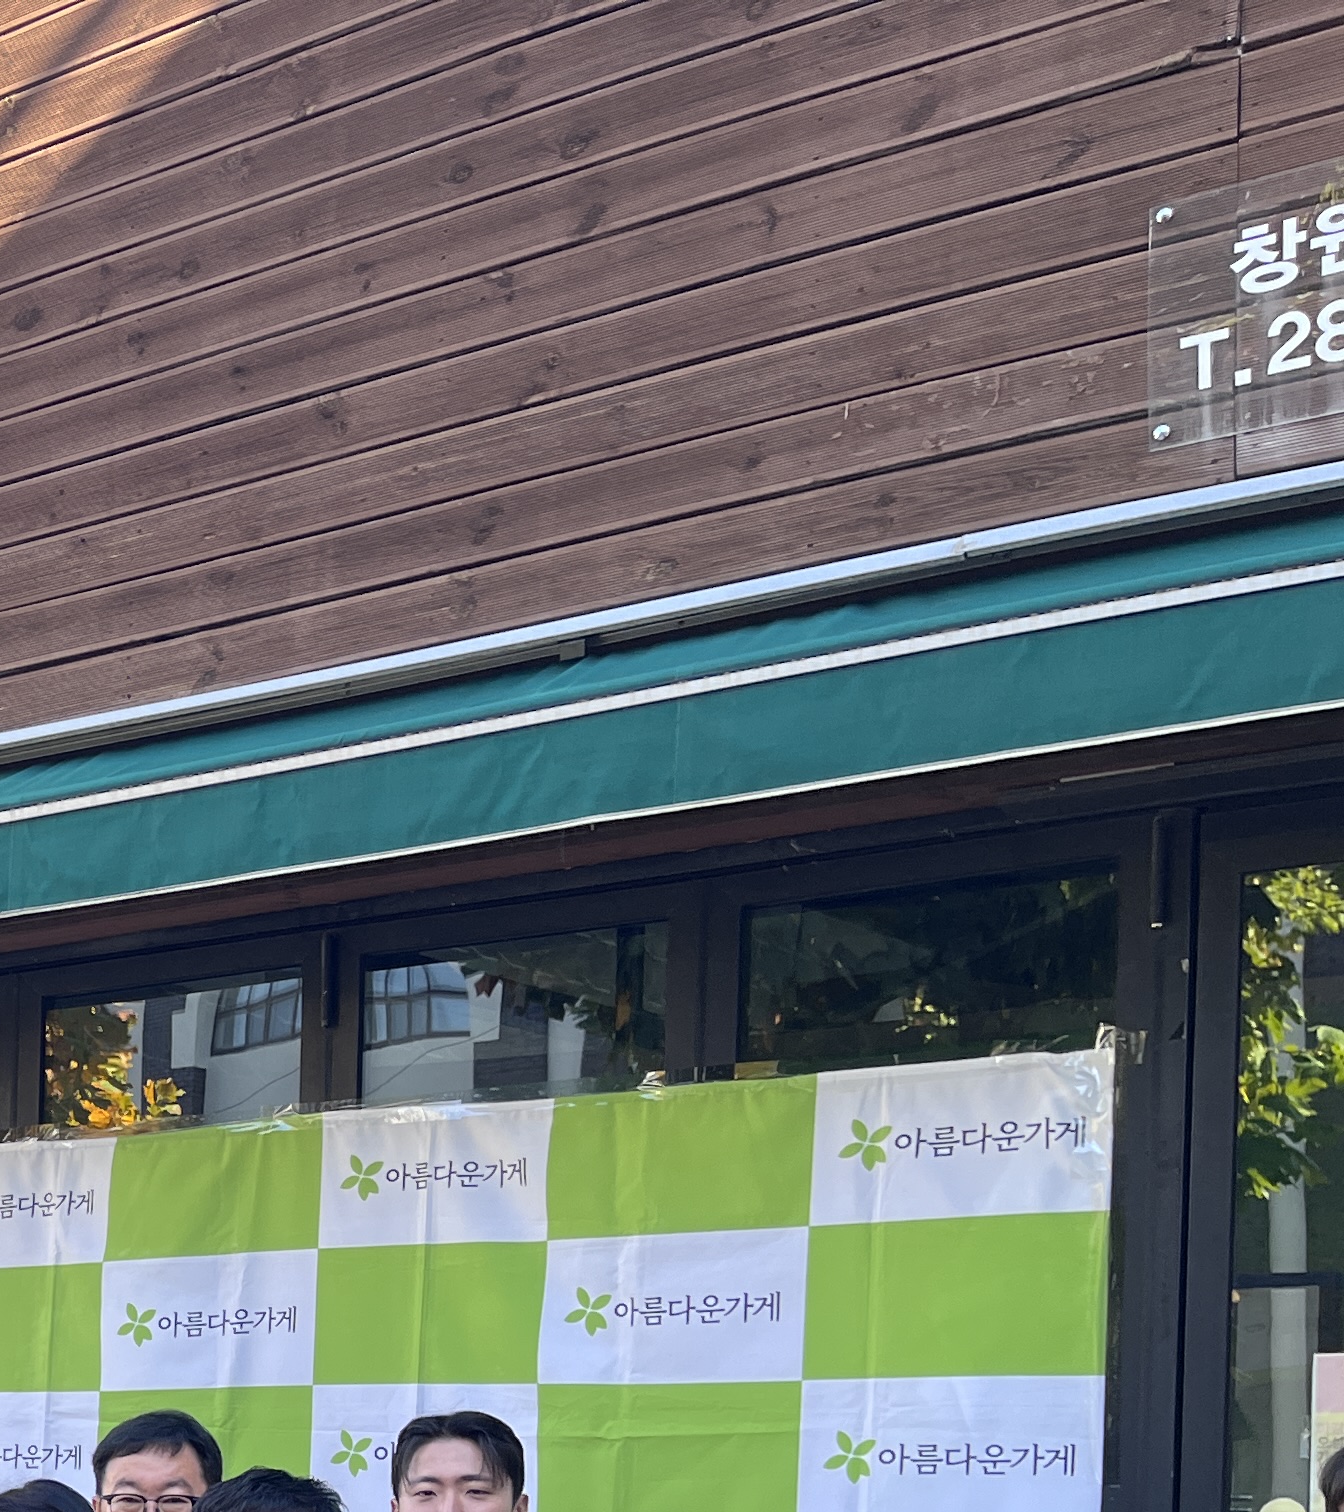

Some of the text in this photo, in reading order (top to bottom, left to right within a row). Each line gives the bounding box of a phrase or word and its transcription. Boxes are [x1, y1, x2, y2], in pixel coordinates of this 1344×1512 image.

[895, 1116, 1087, 1160] 아름다운가게
[386, 1156, 529, 1191] 아름다운가게
[157, 1306, 298, 1339] 아름다운가게
[614, 1291, 782, 1328] 아름다운가게
[878, 1442, 1077, 1478] 아름다운가게
